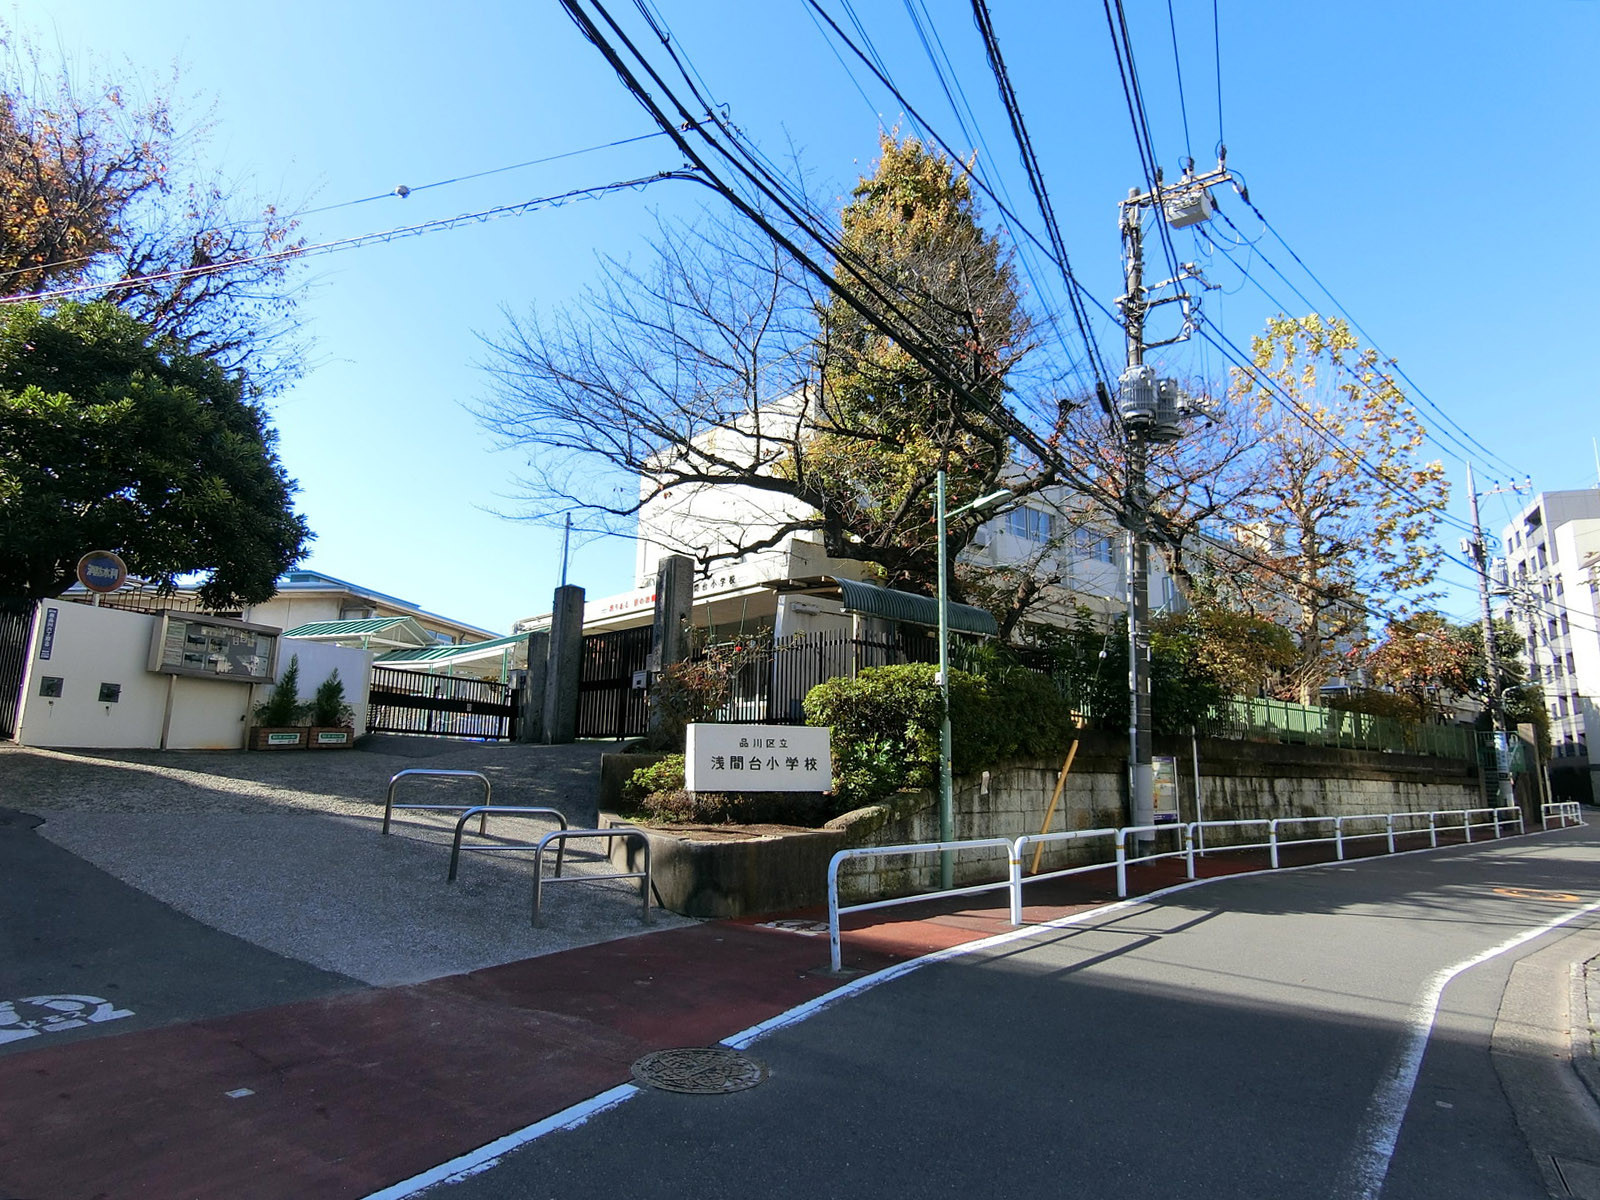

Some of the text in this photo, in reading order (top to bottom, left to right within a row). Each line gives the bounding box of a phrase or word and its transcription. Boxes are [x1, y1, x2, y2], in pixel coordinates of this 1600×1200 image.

[739, 738, 788, 748] 品川区立
[711, 756, 818, 771] 浅間台小学校
